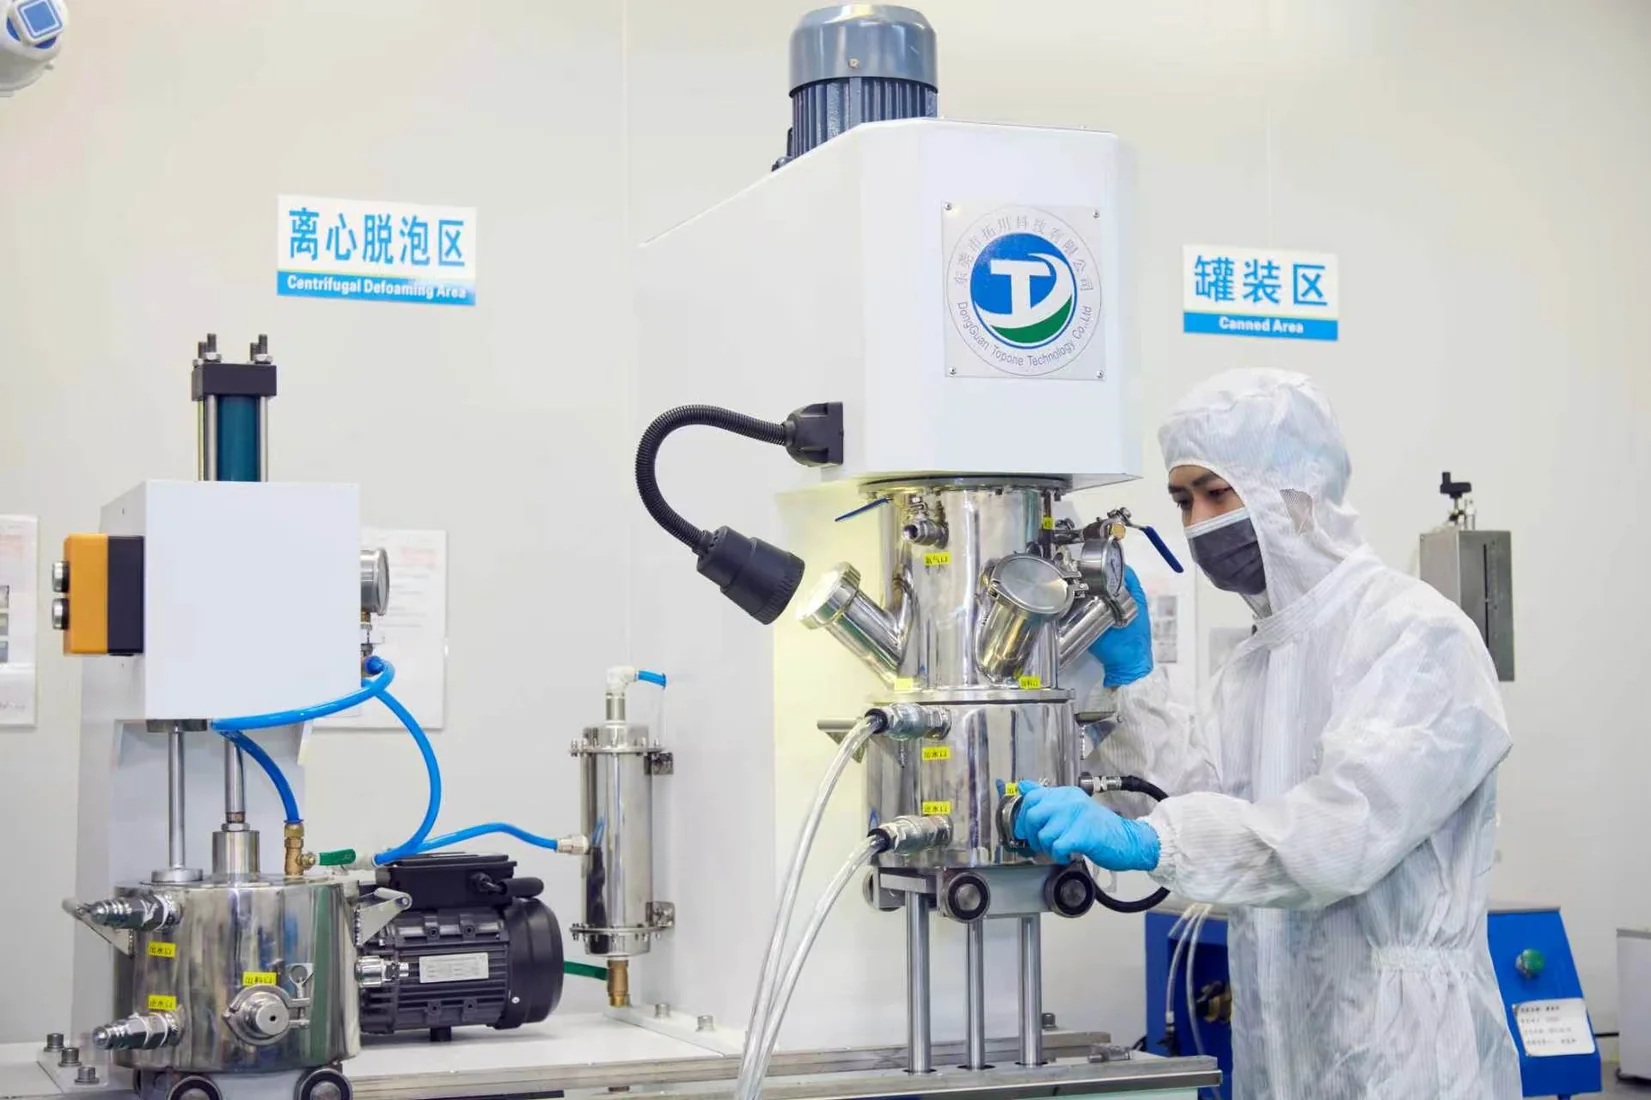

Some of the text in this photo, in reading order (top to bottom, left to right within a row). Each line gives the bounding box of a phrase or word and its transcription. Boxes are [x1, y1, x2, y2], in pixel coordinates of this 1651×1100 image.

[289, 207, 465, 267] 离心脱泡区
[287, 274, 467, 299] Centrifugal Defoaming Area
[1194, 255, 1328, 306] 罐装区
[957, 301, 990, 350] DongGuan
[990, 344, 1024, 366] Topone
[1028, 340, 1076, 366] Technology
[1218, 315, 1304, 334] Canned Area
